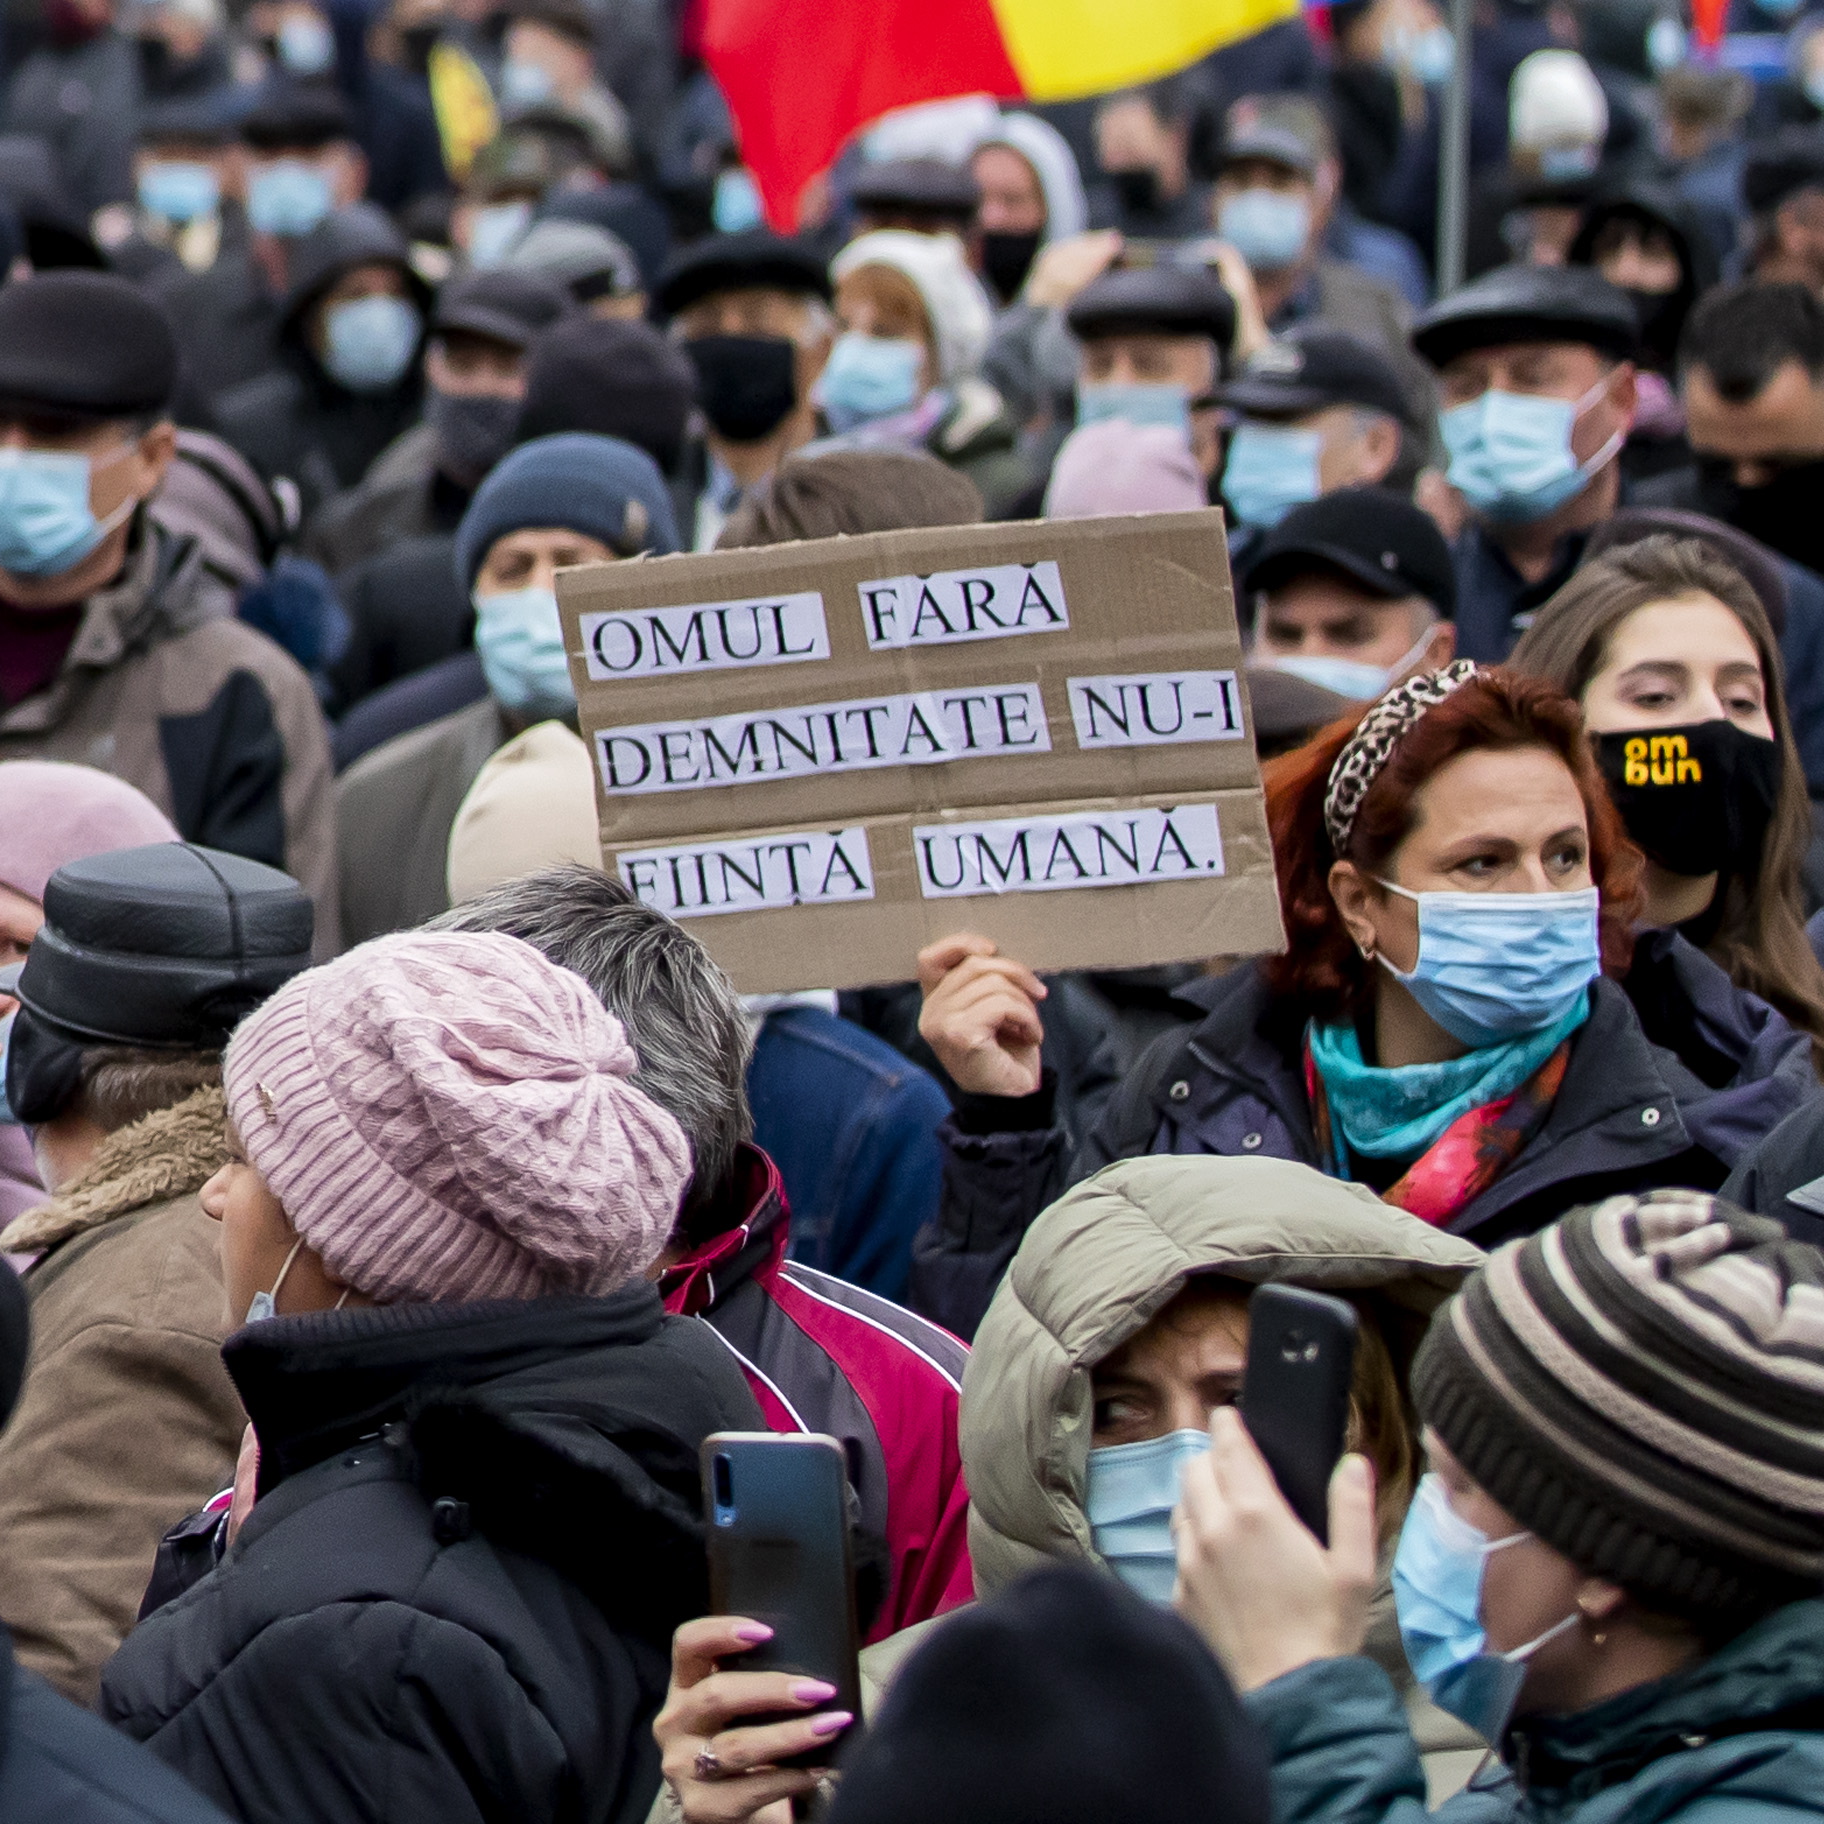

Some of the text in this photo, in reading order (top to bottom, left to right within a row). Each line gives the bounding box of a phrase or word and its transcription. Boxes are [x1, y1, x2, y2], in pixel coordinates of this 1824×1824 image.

[591, 562, 1067, 673] OMUL FĂRĂ
[600, 678, 1242, 790] DEMNITATE NU-I
[918, 806, 1216, 889] UMANĂ.
